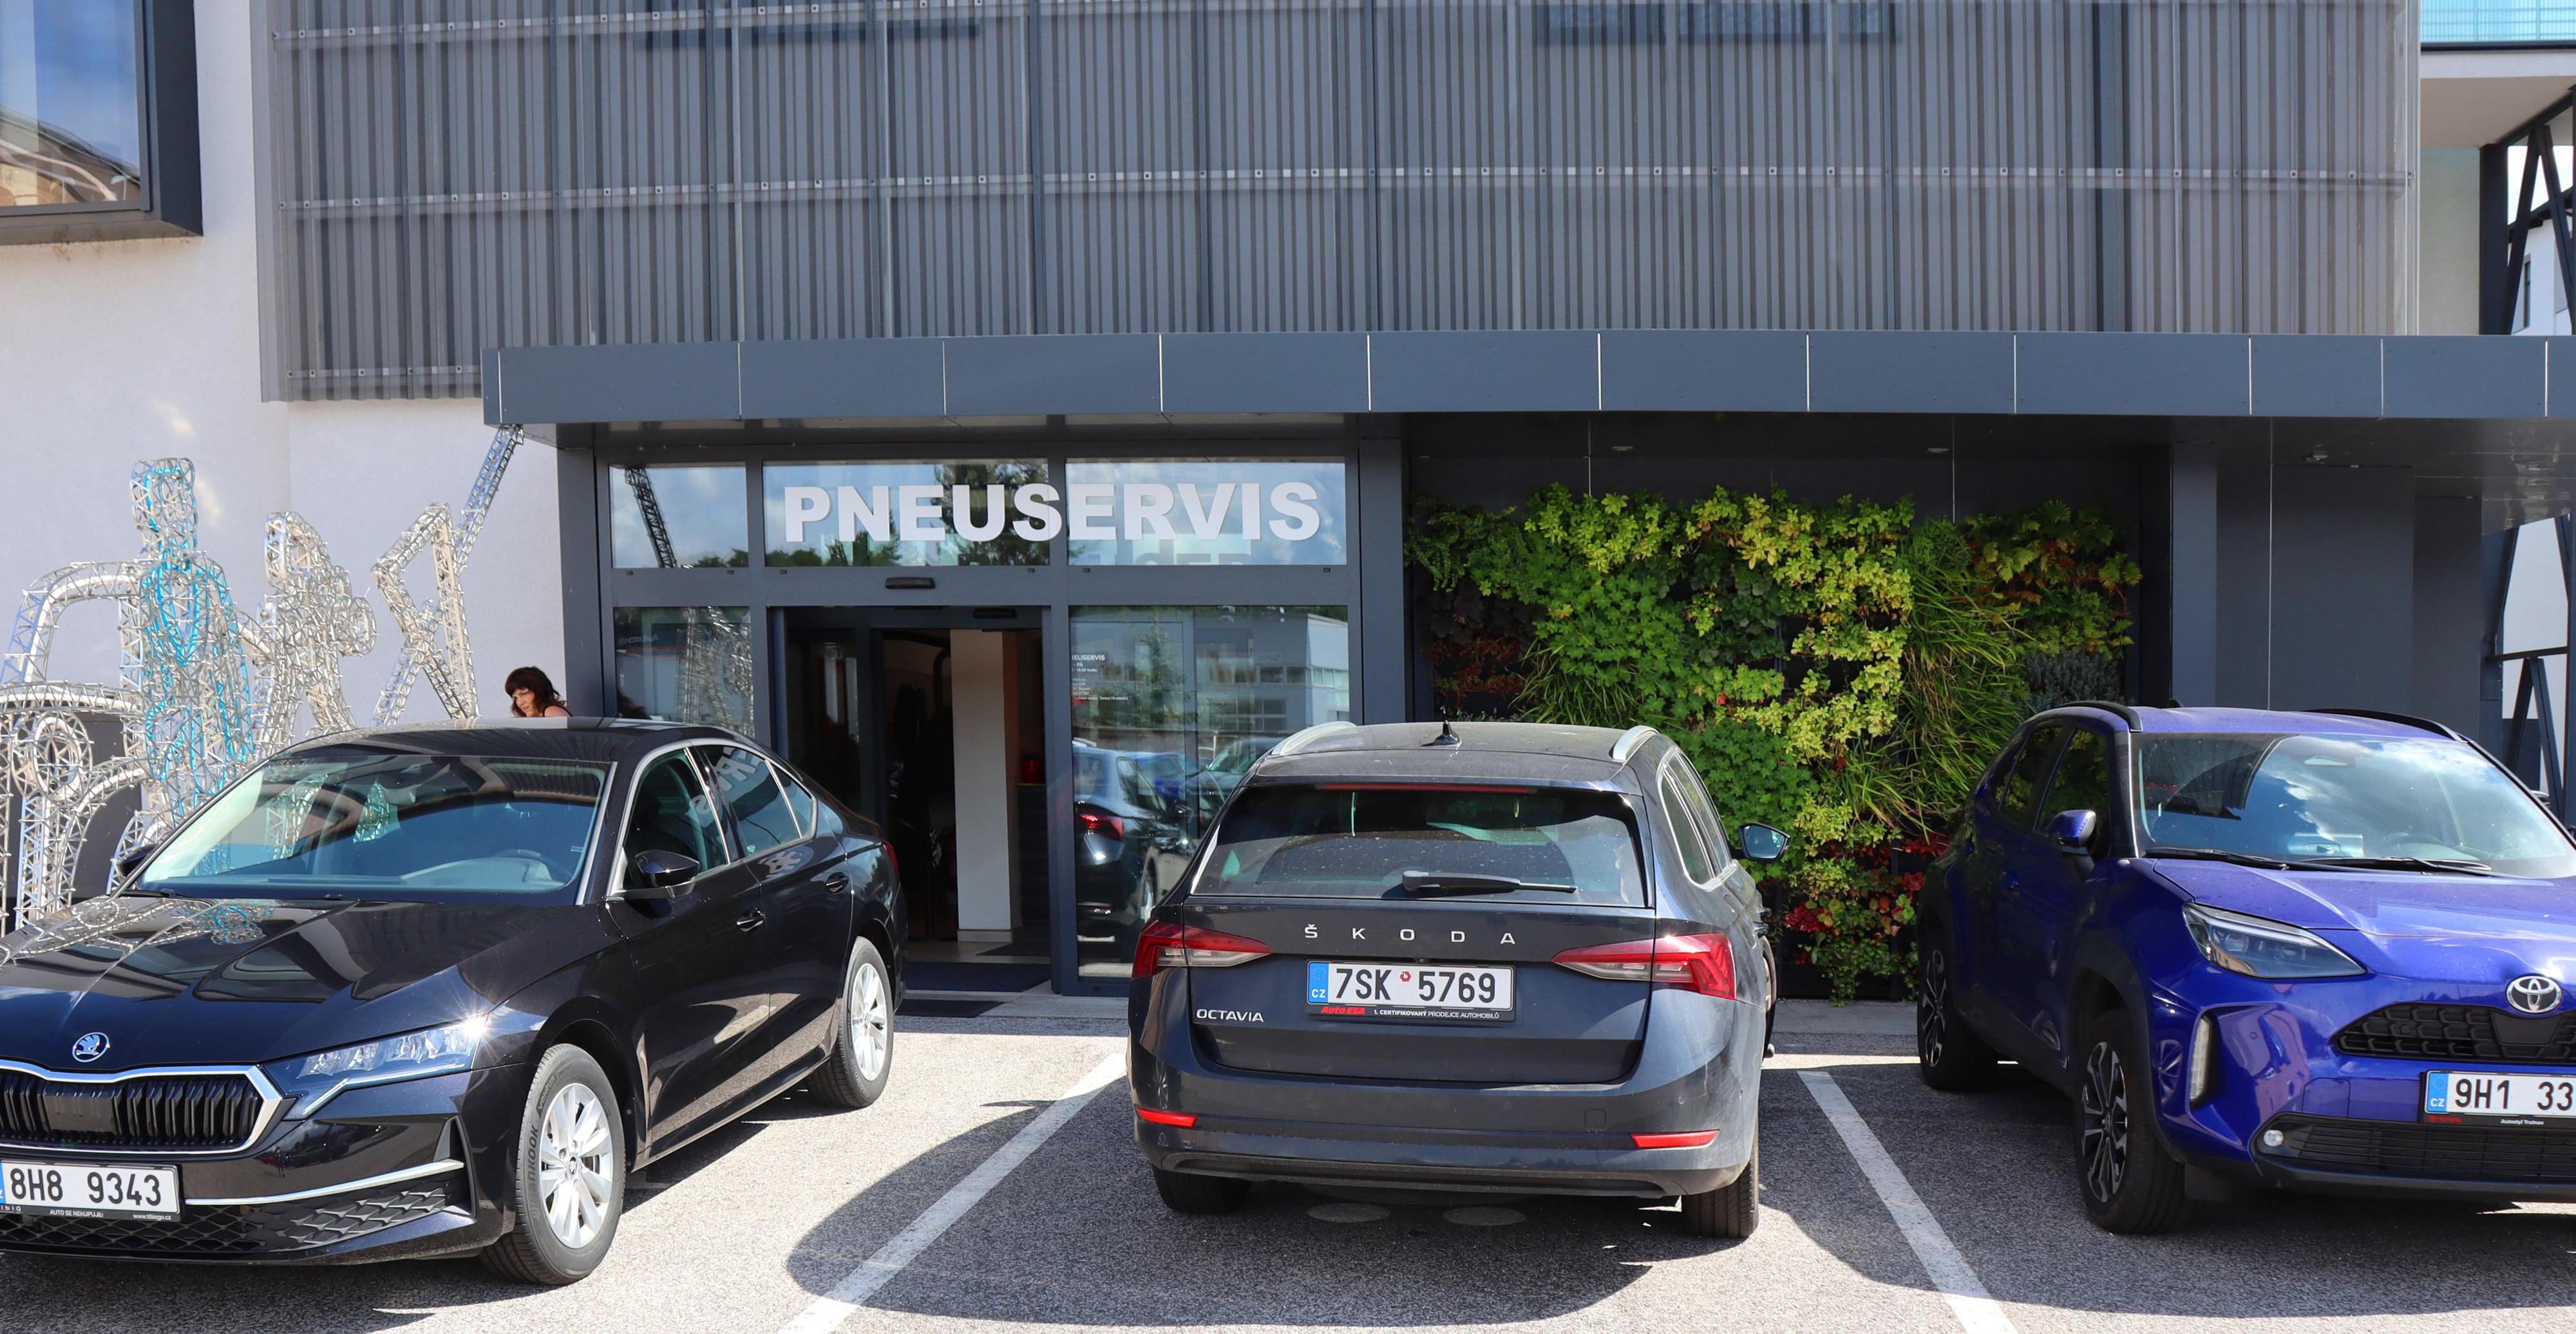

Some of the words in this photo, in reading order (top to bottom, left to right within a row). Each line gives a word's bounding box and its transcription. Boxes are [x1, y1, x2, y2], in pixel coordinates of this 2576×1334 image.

[785, 482, 1321, 543] PNEUSERVIS
[1304, 924, 1515, 944] ŠKODA
[1311, 989, 1326, 999] CZ
[1336, 968, 1392, 1000] 7SK
[1418, 971, 1495, 1003] 5769
[1197, 1009, 1264, 1022] OCTAVIA
[1321, 1006, 1345, 1015] Auto
[1346, 1007, 1366, 1015] ESA
[2430, 1098, 2445, 1107] CZ
[2455, 1078, 2510, 1109] 9H1
[10, 1168, 63, 1201] 8H8
[87, 1172, 161, 1206] 9343
